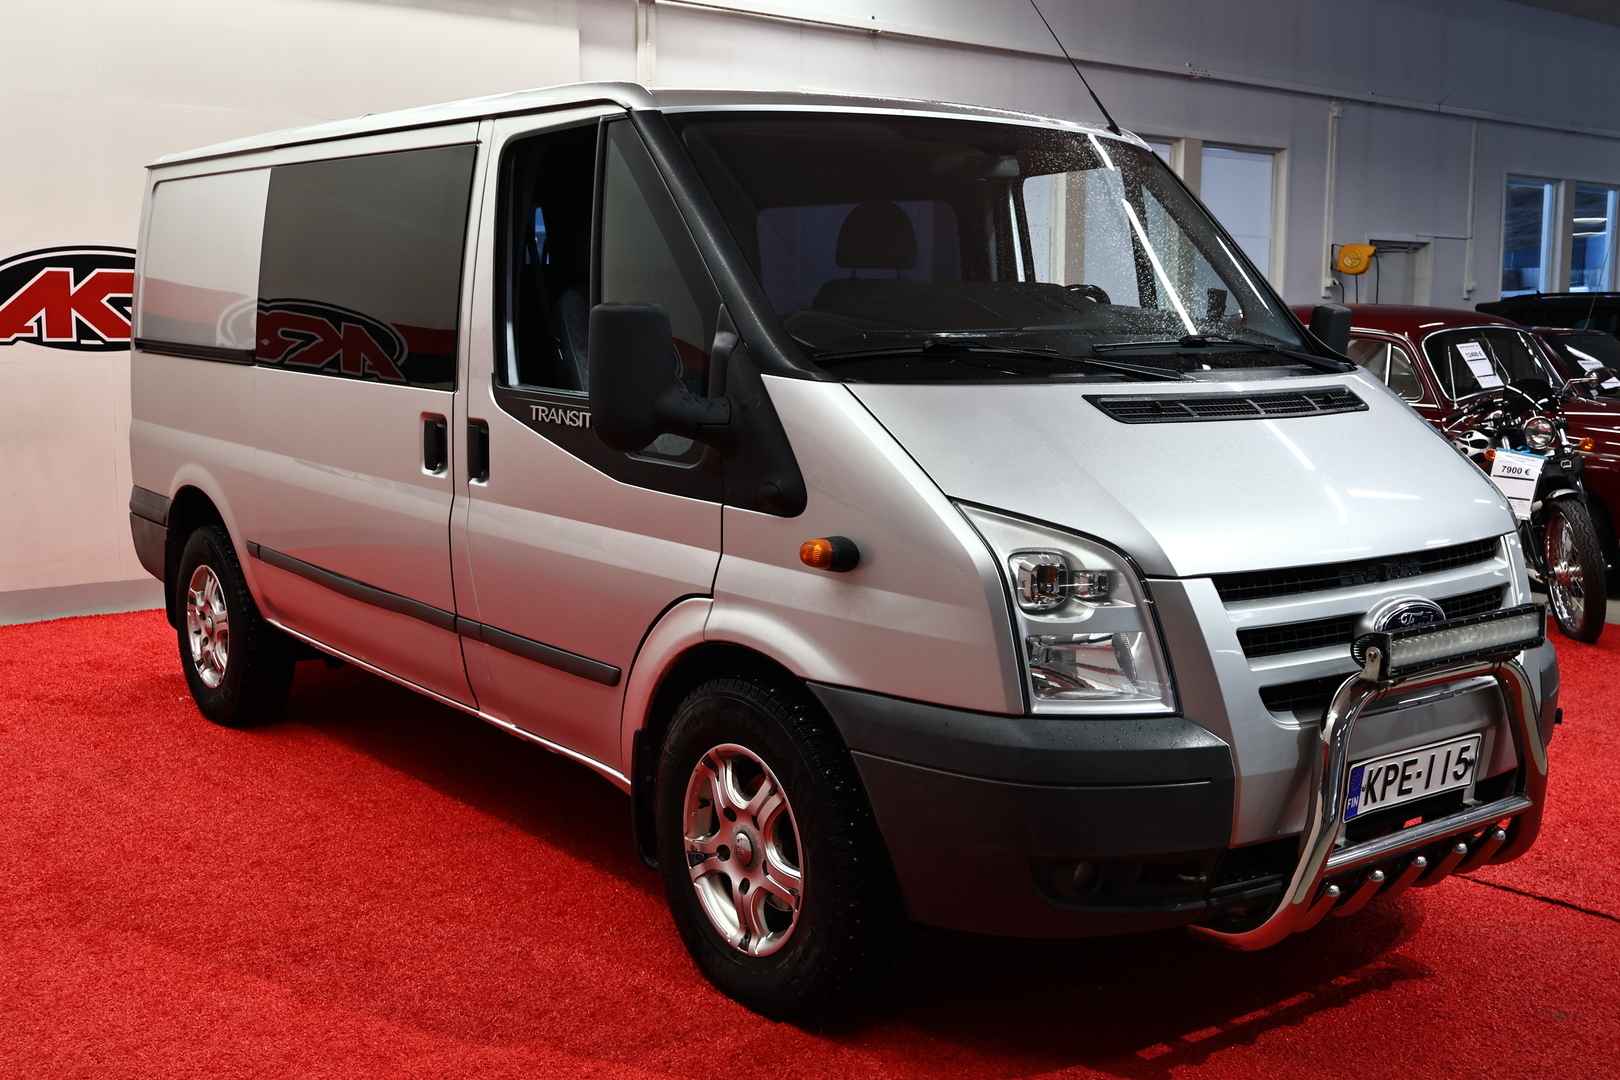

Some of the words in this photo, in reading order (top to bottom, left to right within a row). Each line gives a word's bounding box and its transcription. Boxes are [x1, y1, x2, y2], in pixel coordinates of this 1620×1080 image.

[0, 267, 134, 342] AK
[530, 405, 591, 428] TRANSIT
[1501, 465, 1522, 475] 7900
[1524, 468, 1531, 476] €
[1363, 743, 1472, 807] KPE-115
[1346, 796, 1360, 810] FIN
